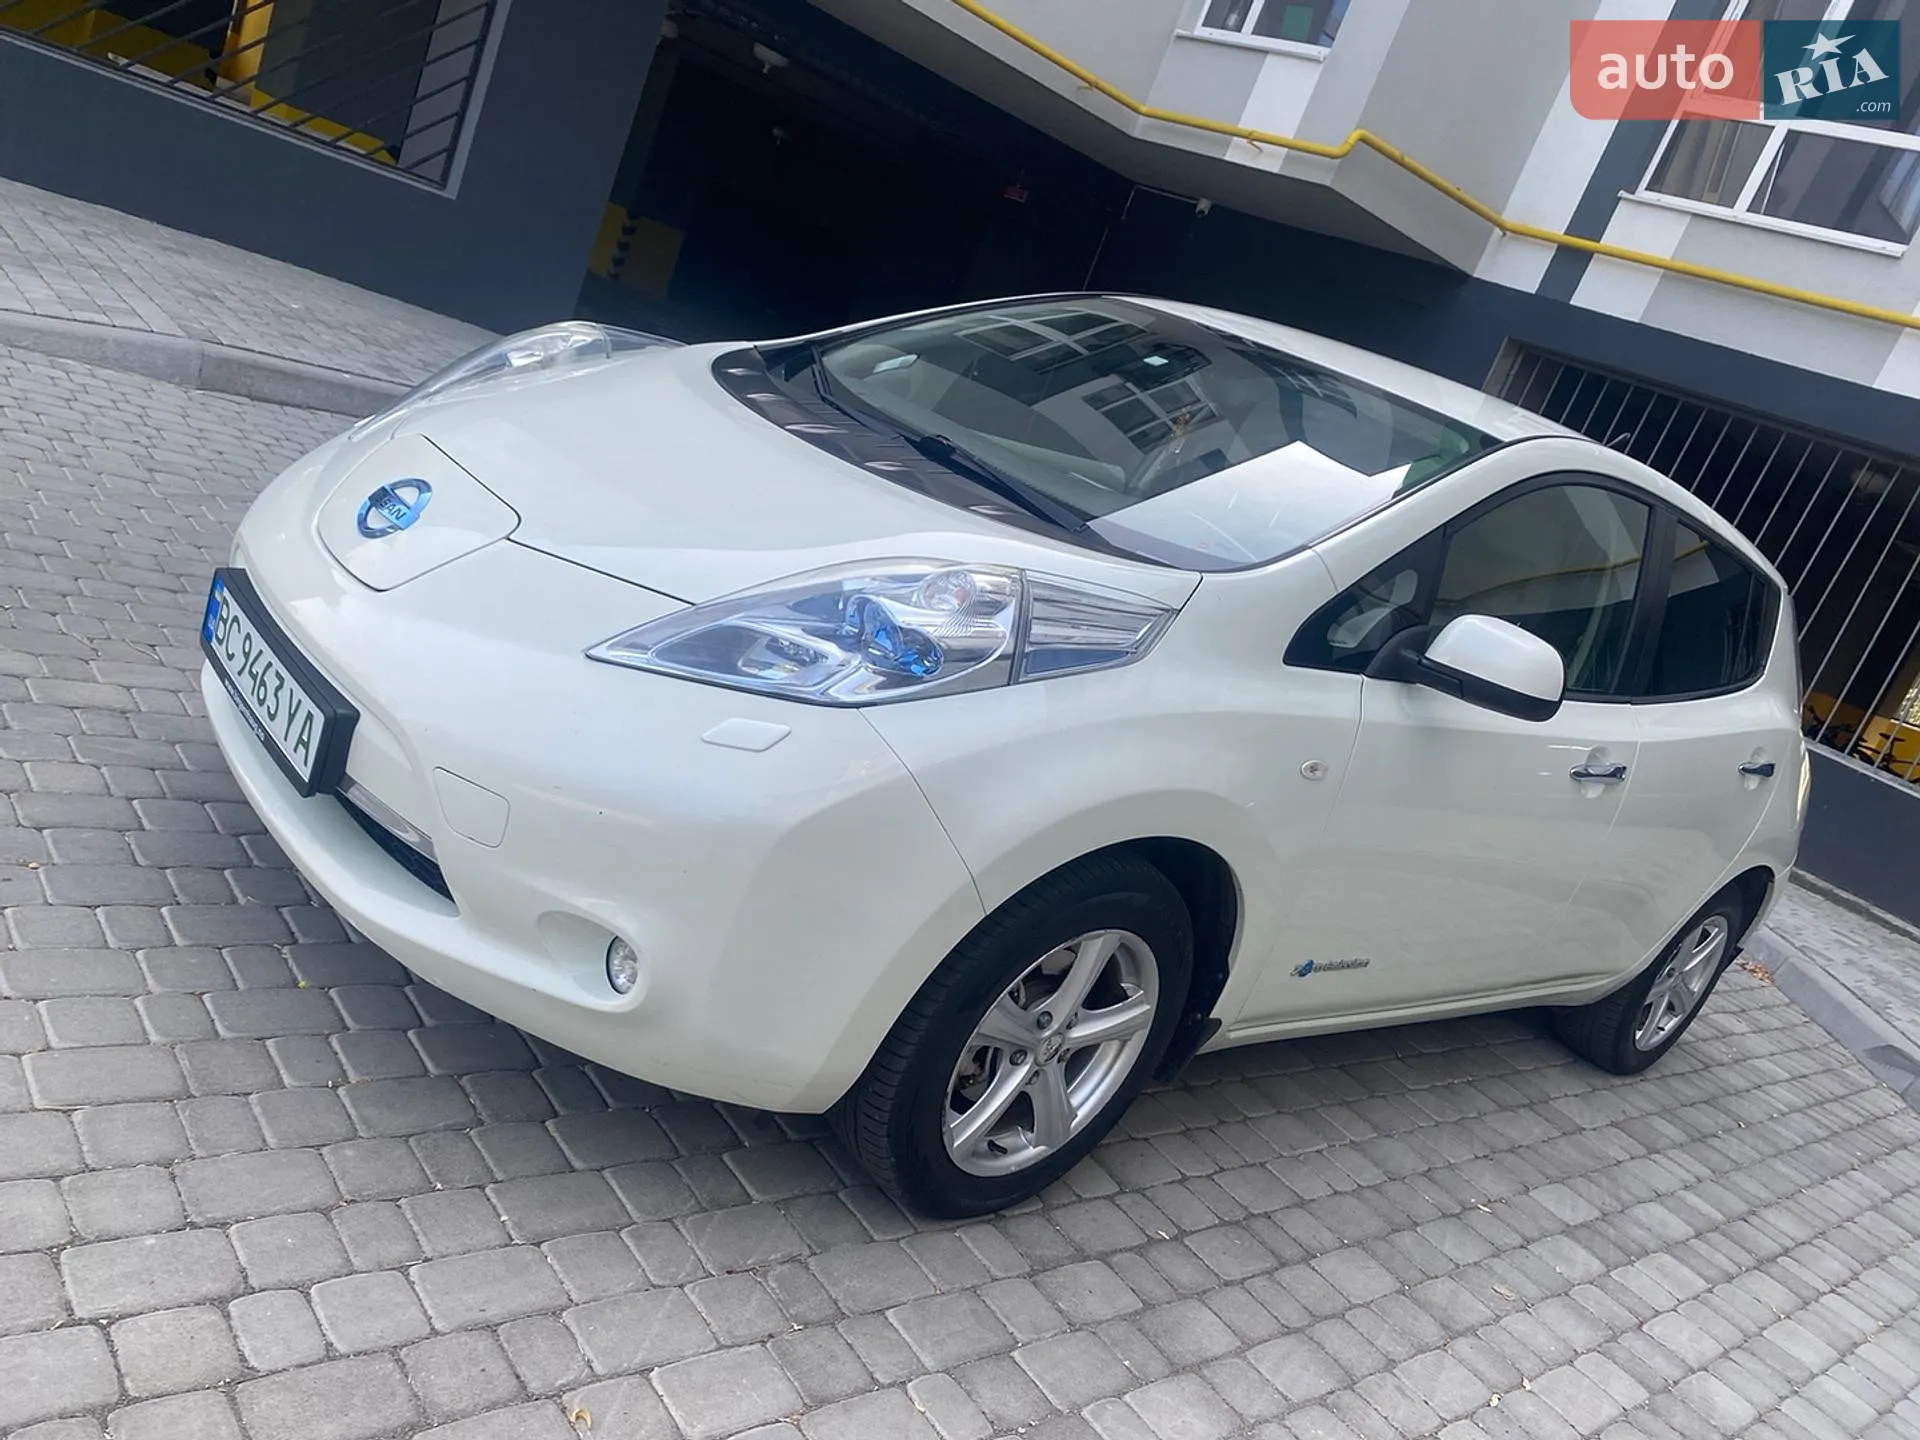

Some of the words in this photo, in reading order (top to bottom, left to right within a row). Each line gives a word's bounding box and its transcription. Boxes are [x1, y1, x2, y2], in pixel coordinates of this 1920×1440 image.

[213, 598, 241, 662] BC
[237, 631, 285, 722] 9463
[283, 687, 315, 767] YA
